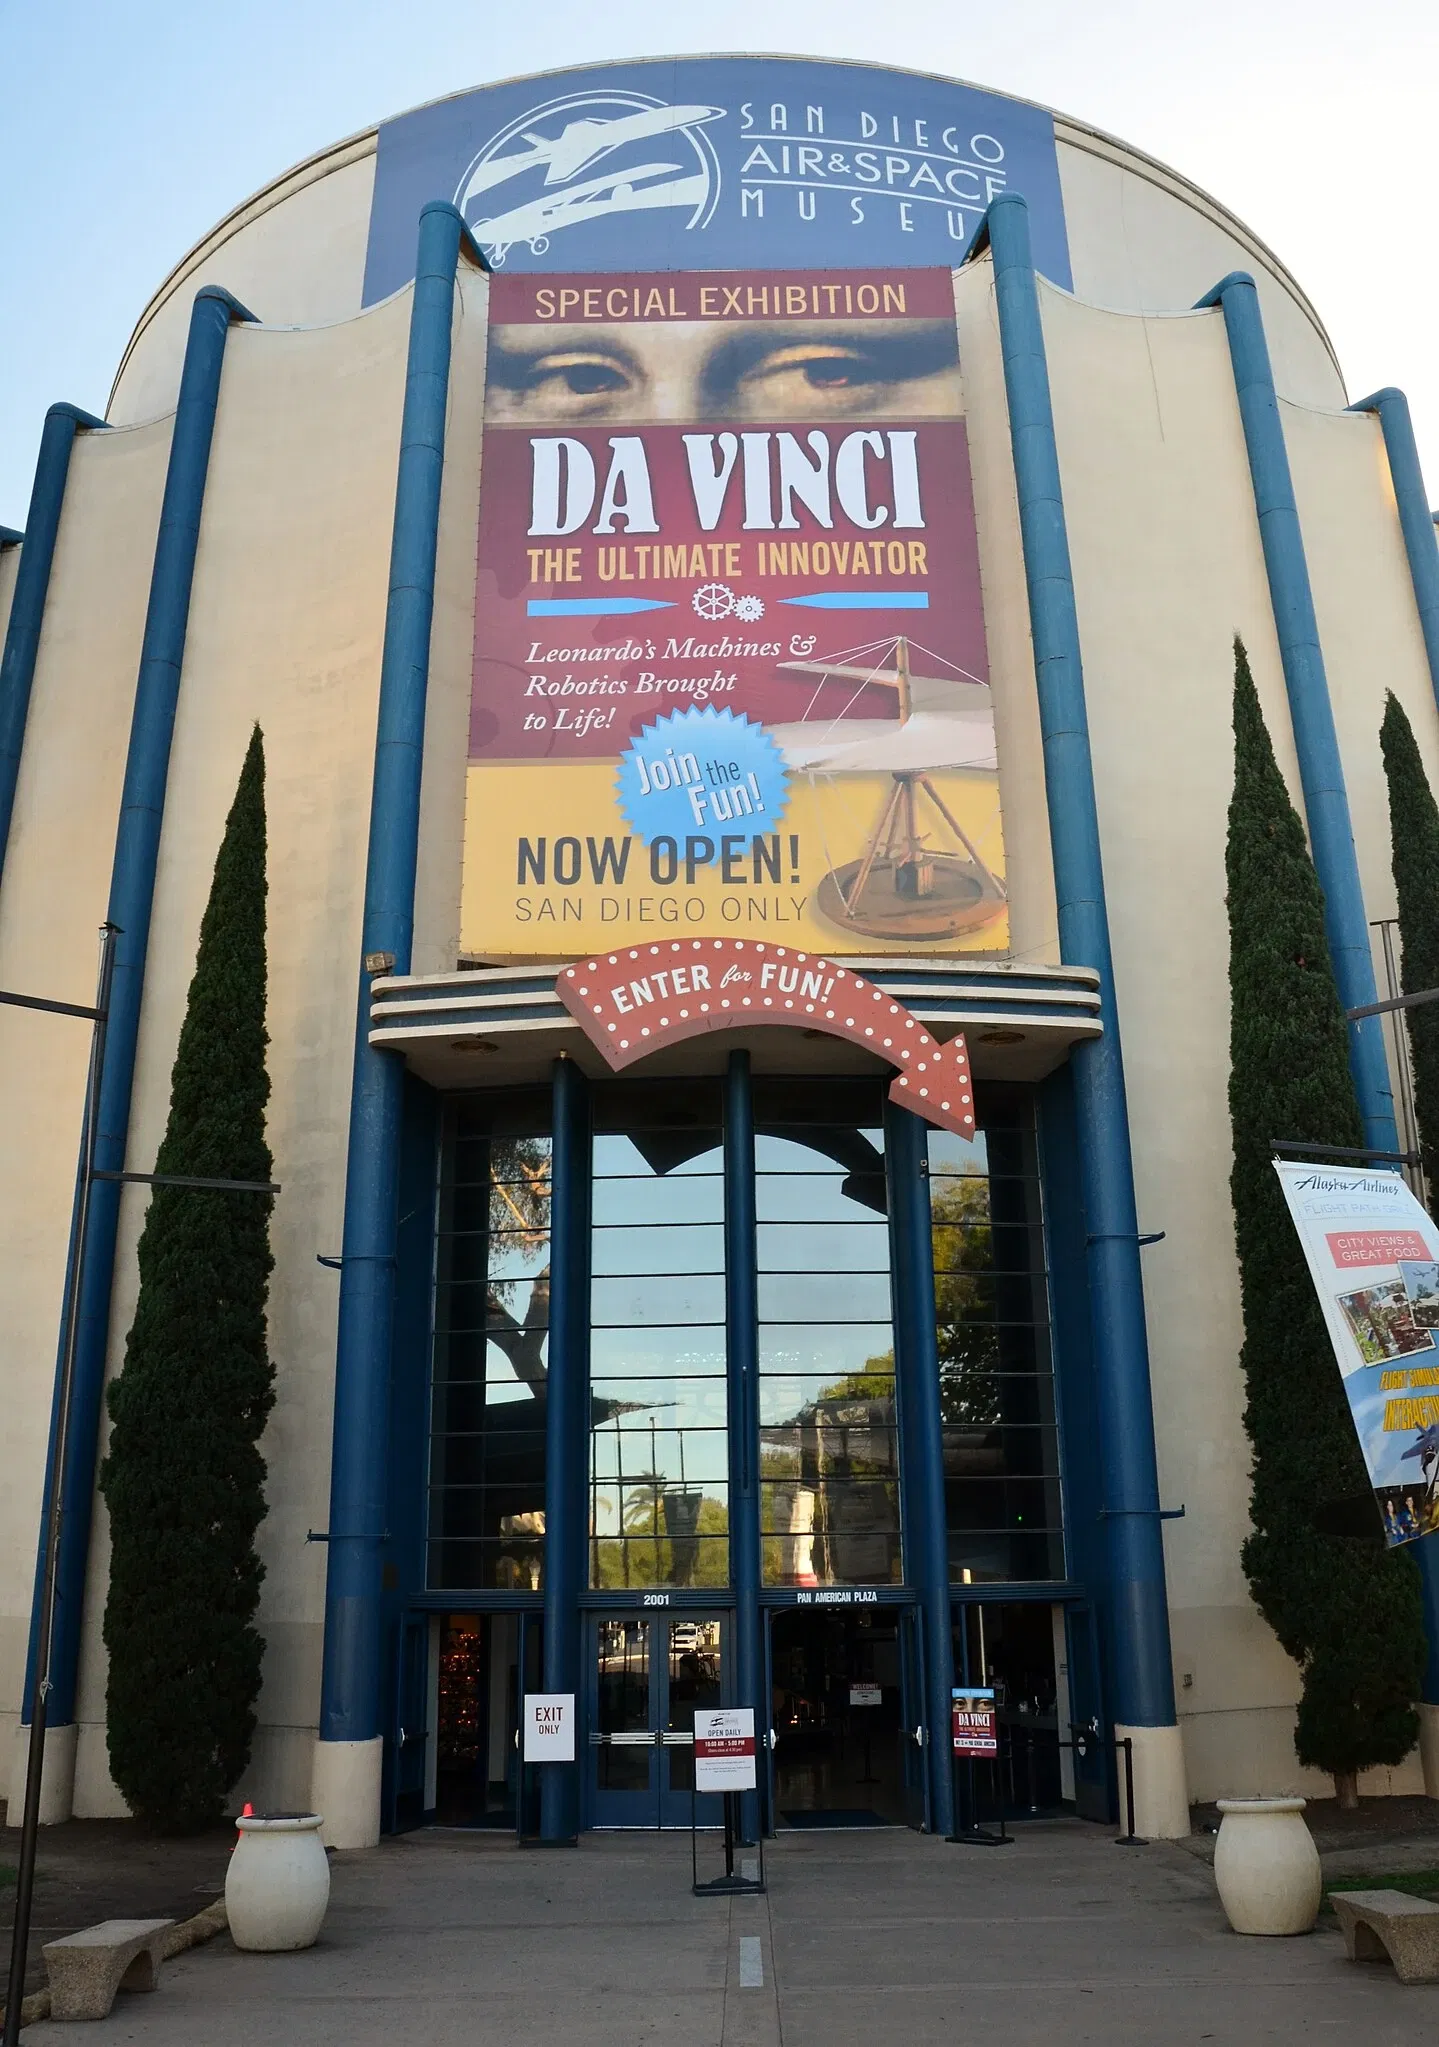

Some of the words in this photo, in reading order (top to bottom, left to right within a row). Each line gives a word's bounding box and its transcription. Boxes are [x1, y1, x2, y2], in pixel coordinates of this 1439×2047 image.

[741, 103, 824, 133] SAN
[861, 112, 1005, 163] DIEGO
[741, 189, 964, 240] MUSEU
[535, 288, 687, 318] SPECIAL
[700, 285, 906, 316] EXHIBITION
[527, 436, 660, 536] DA
[682, 430, 926, 530] VINCI
[527, 549, 582, 583] THE
[598, 543, 742, 580] ULTIMATE
[758, 541, 928, 575] INNOVATOR
[525, 640, 656, 664] Leonardo's
[661, 637, 781, 660] Machines
[789, 634, 817, 656] &
[524, 674, 628, 697] Robotics
[633, 670, 738, 700] Brought
[523, 711, 547, 731] to
[552, 707, 616, 738] Life!
[635, 748, 702, 795] Join
[706, 759, 741, 787] the
[686, 771, 766, 827] Fun!
[517, 836, 632, 885] NOW
[650, 834, 800, 884] OPEN!
[515, 897, 583, 922] SAN
[601, 897, 706, 922] DIEGO
[721, 896, 808, 921] ONLY
[610, 965, 712, 1015] ENTER
[720, 964, 752, 989] for
[761, 963, 835, 1004] FUN!
[1294, 1175, 1349, 1192] Alaska
[1349, 1179, 1399, 1196] Airlines
[1337, 1238, 1365, 1249] CITY
[1367, 1236, 1405, 1247] VIEWS
[1342, 1249, 1383, 1262] GREAT
[1386, 1247, 1421, 1259] FOOD
[1380, 1371, 1408, 1390] FLIGHT
[644, 1594, 670, 1606] 2001
[797, 1593, 812, 1604] PAN
[815, 1592, 851, 1603] AMERICAN
[854, 1591, 878, 1602] PLAZA
[535, 1706, 564, 1722] EXIT
[958, 1713, 969, 1726] DA
[970, 1713, 990, 1727] VINCI
[538, 1724, 560, 1735] ONLY
[725, 1728, 742, 1736] DAILY
